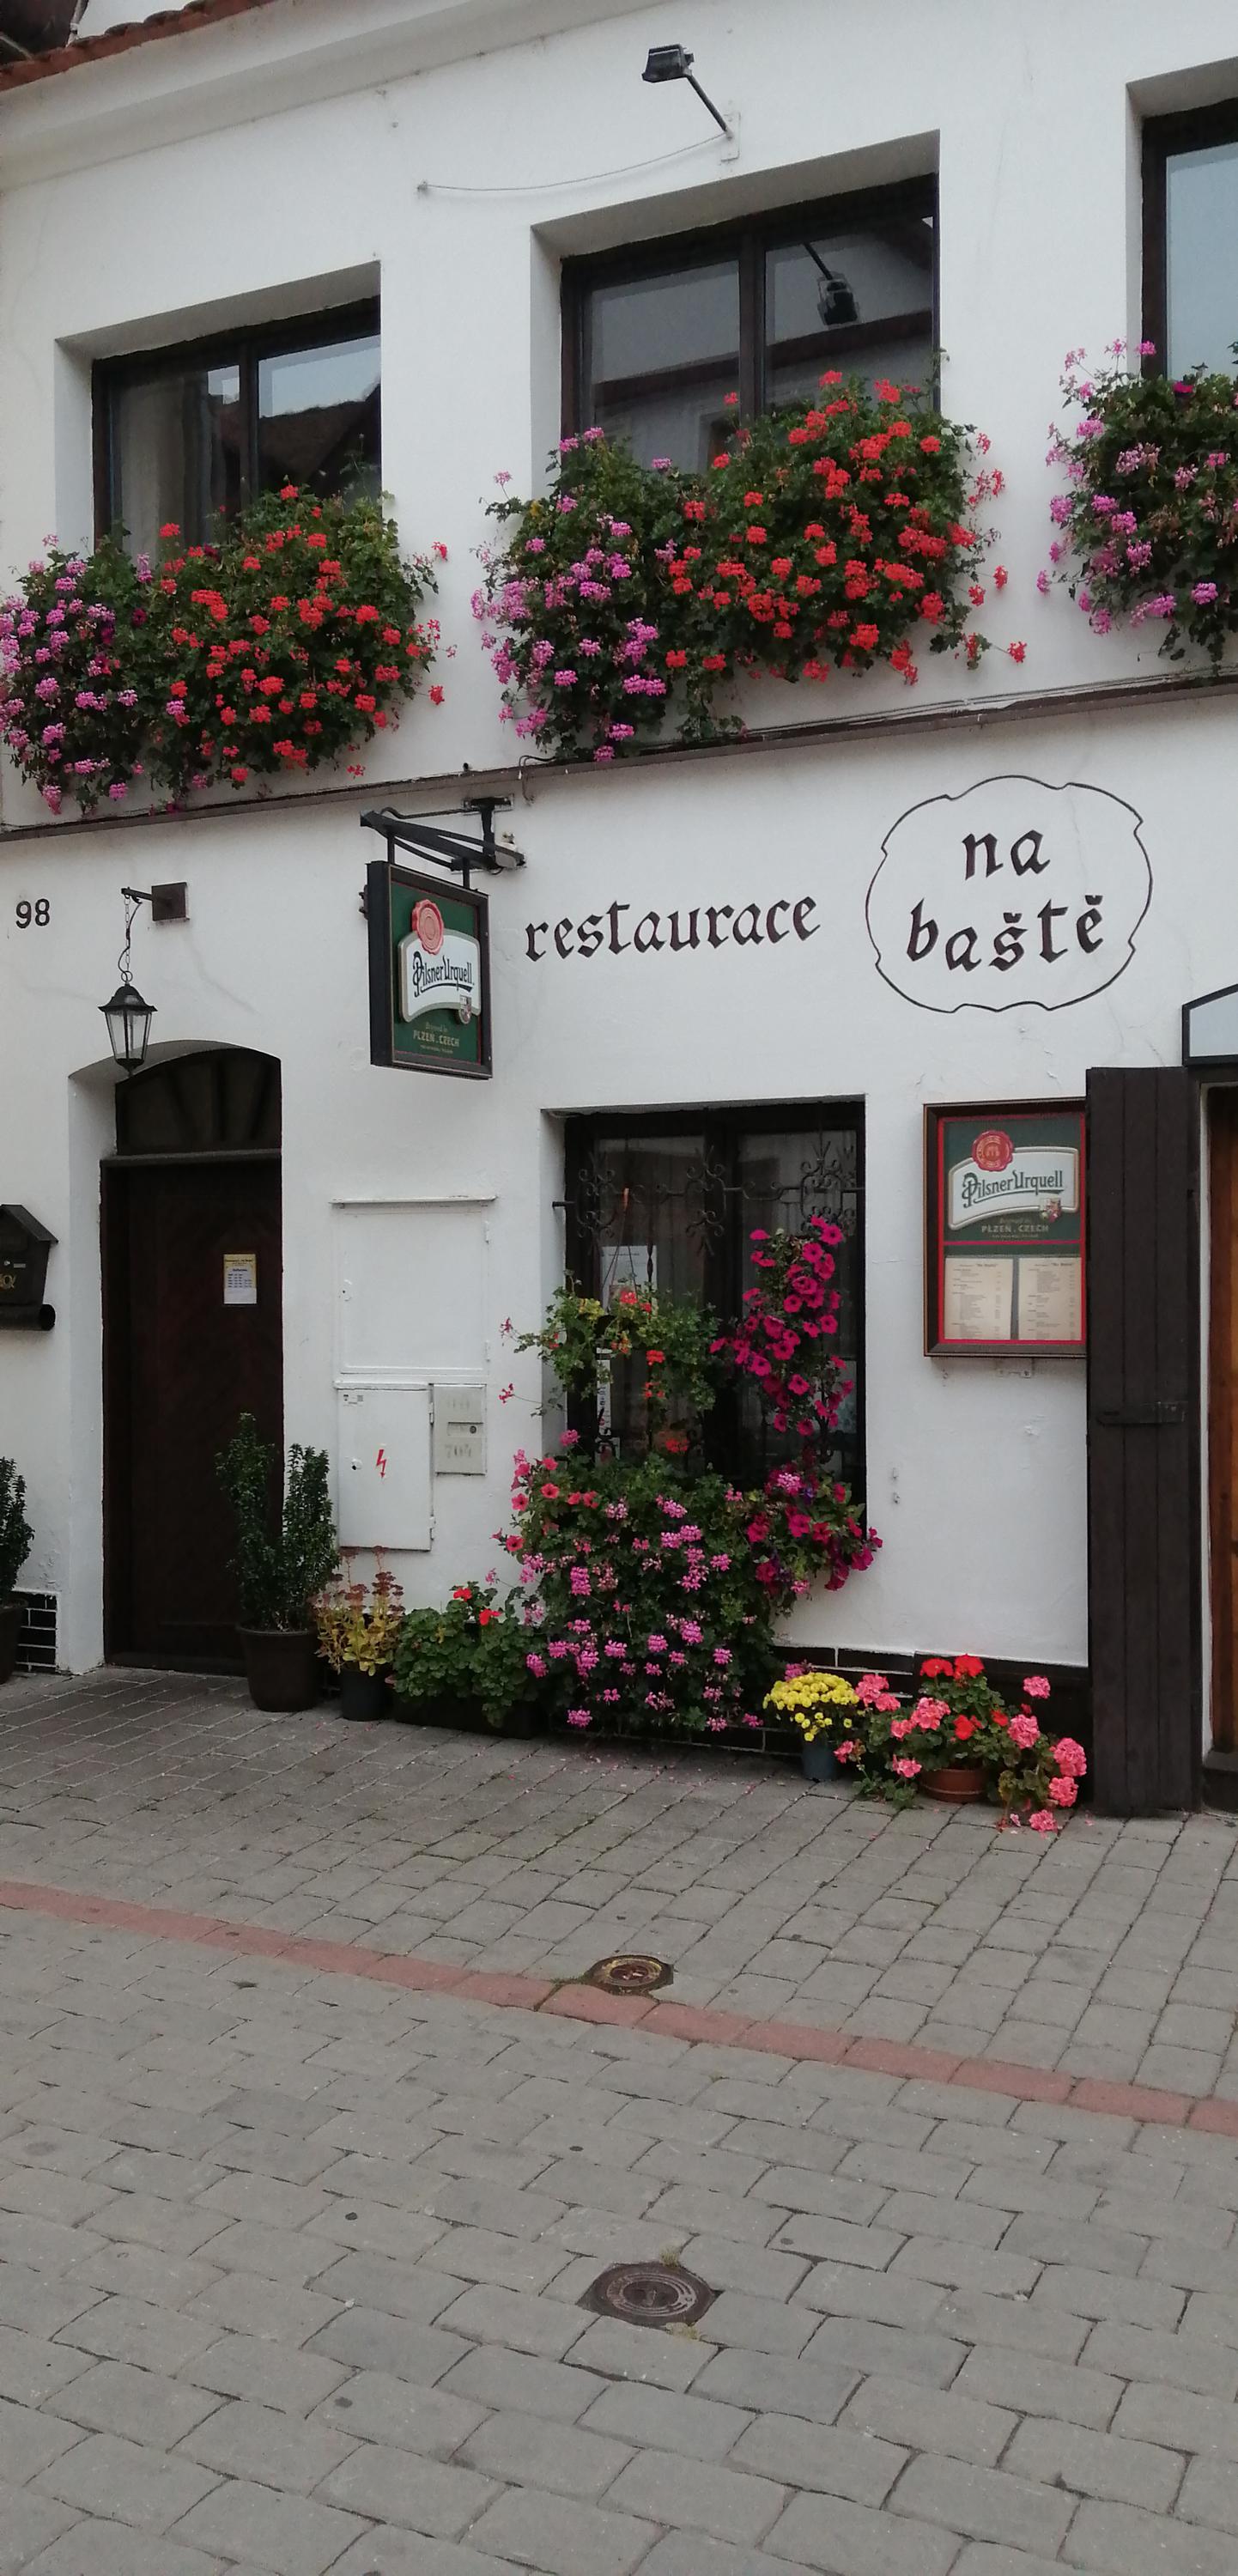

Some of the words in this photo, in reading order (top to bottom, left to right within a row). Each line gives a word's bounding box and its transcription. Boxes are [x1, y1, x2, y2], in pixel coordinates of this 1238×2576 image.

[962, 829, 1051, 881] na
[15, 898, 51, 929] 98
[525, 896, 822, 963] restaurace
[906, 895, 1104, 972] baště
[412, 951, 444, 998] Pilsner
[442, 955, 473, 992] Urquell
[961, 1172, 1014, 1209] Pilsner
[1012, 1170, 1064, 1196] Urquell
